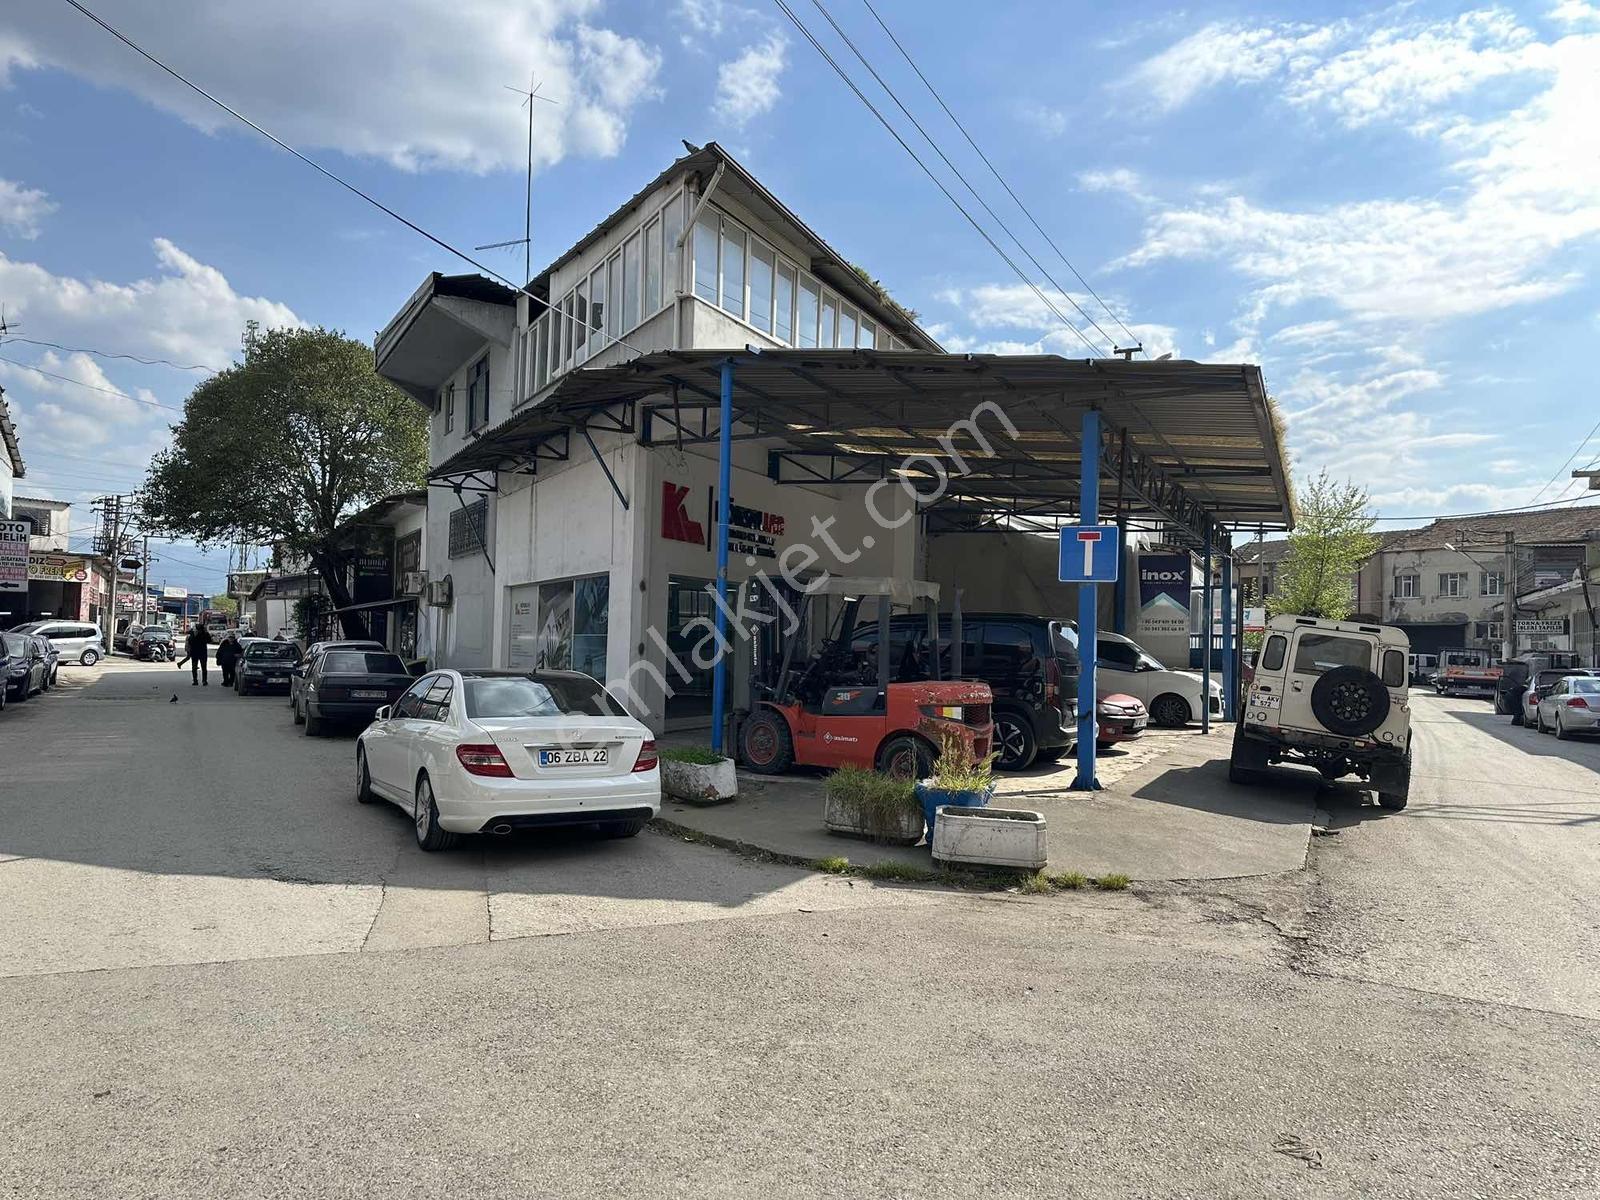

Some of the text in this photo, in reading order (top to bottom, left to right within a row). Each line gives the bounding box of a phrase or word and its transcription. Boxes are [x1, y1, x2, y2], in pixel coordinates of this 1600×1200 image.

[1142, 569, 1186, 581] inox
[837, 692, 851, 701] 30
[547, 750, 606, 763] 06 ZBA 22
